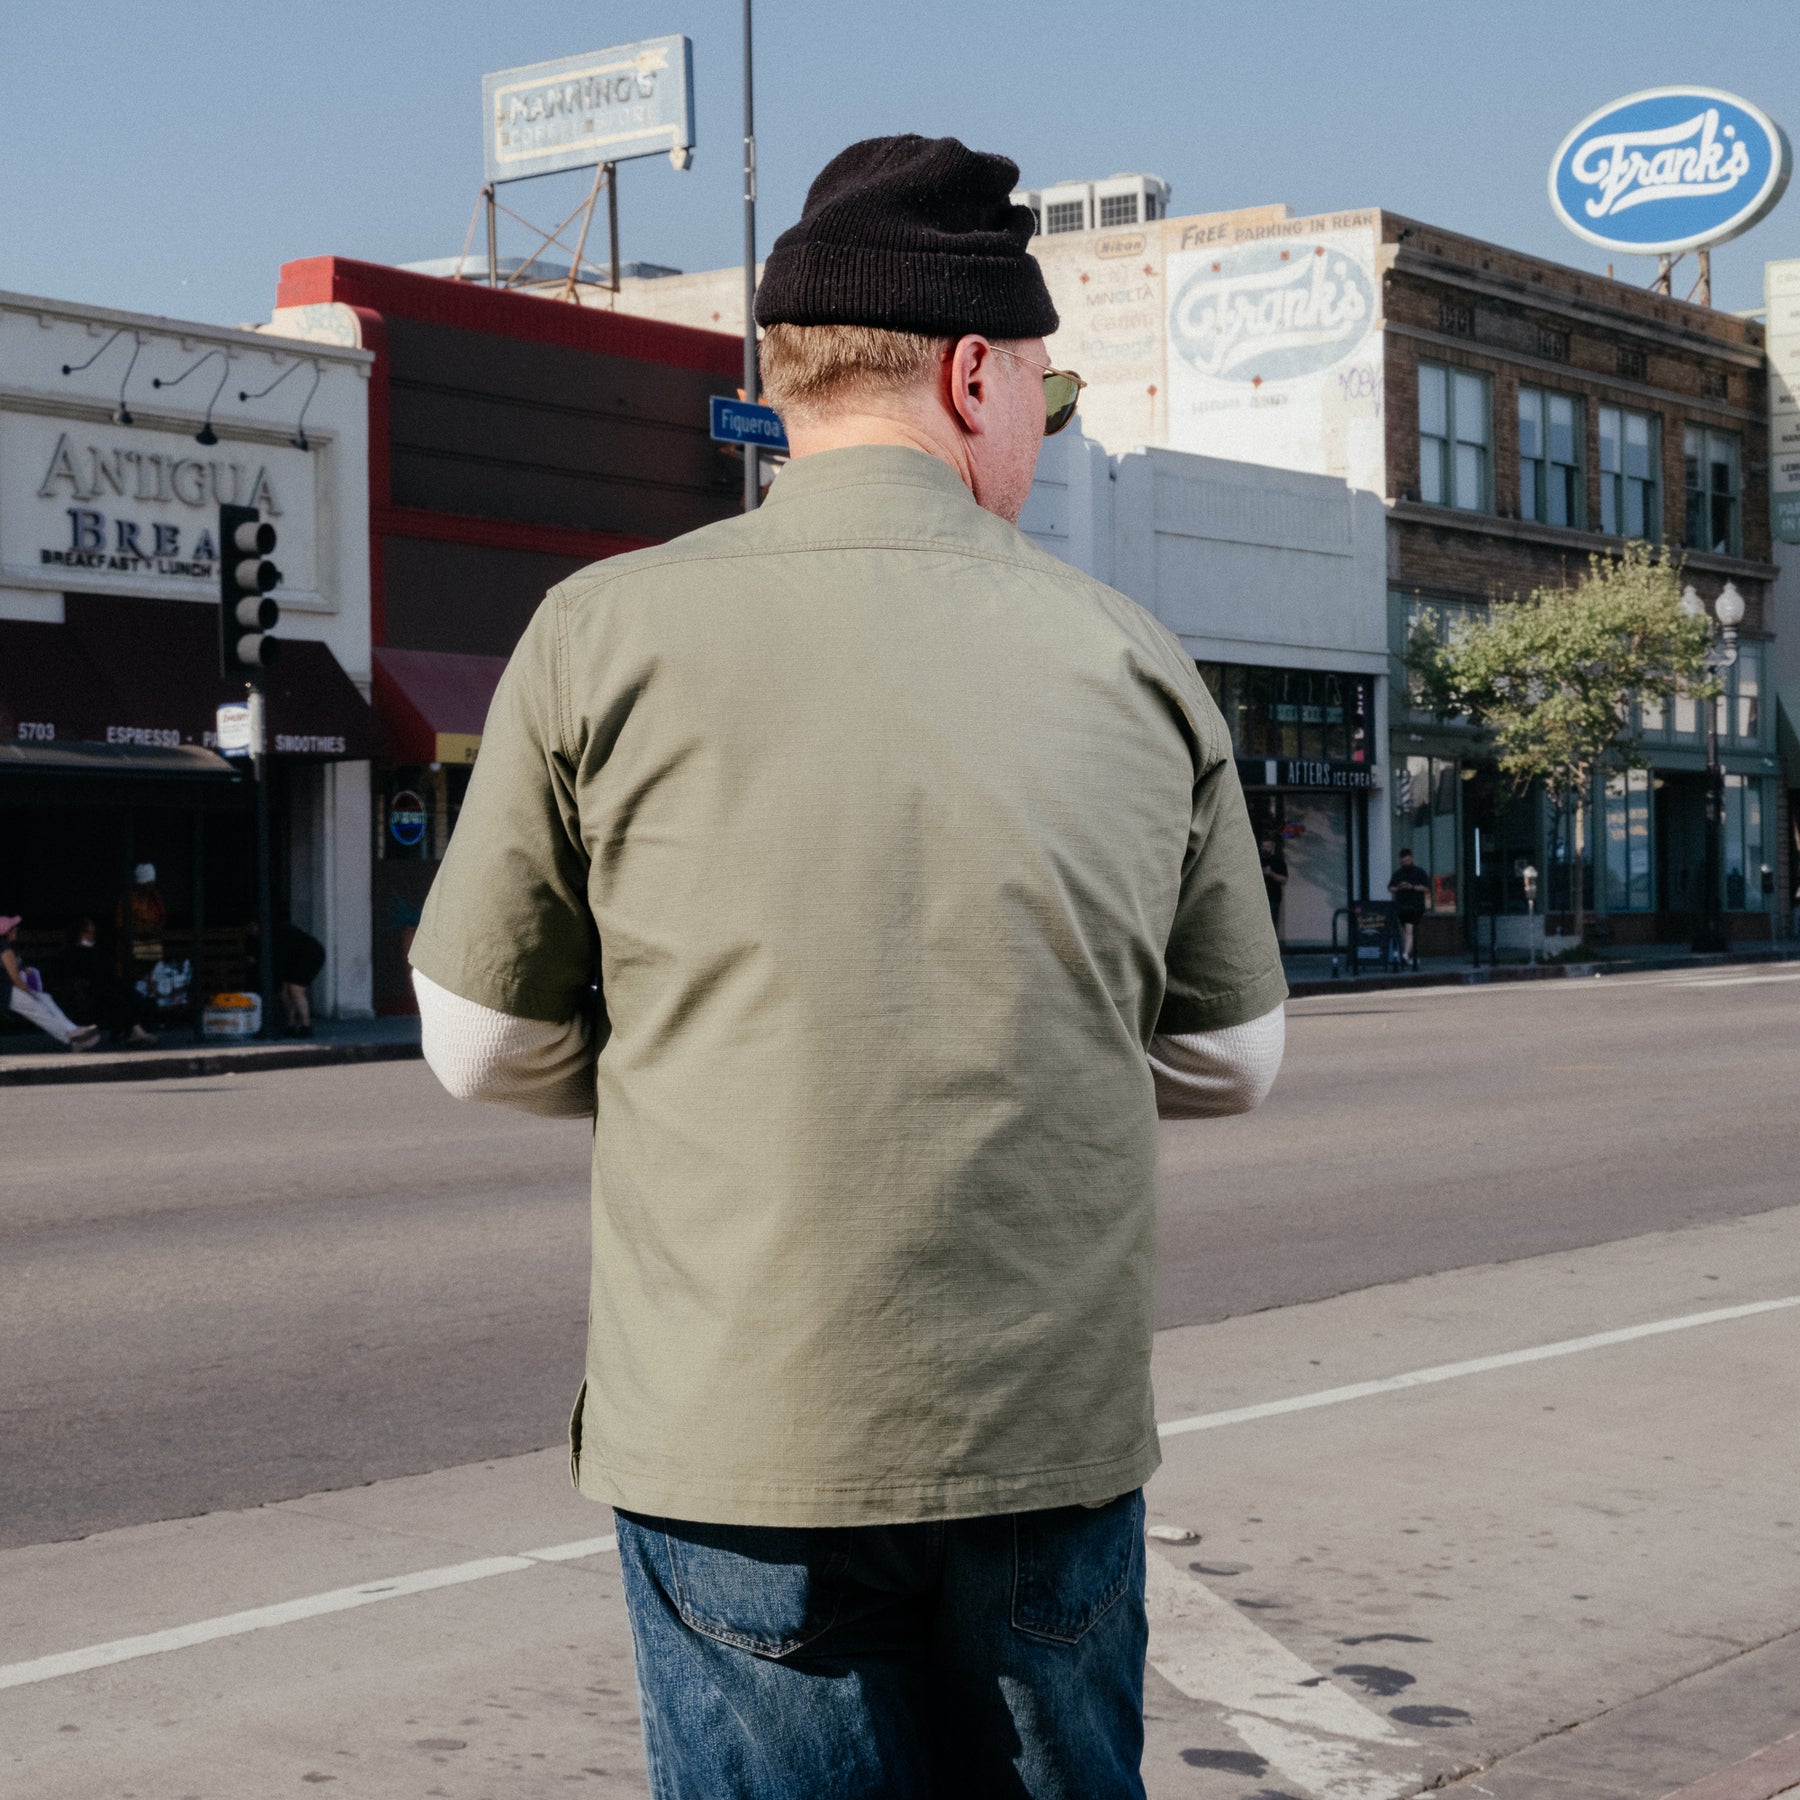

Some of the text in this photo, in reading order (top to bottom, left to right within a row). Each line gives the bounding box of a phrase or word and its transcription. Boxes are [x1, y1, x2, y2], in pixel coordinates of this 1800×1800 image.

[1571, 107, 1750, 218] Frank's
[1100, 240, 1142, 253] Nikon
[1181, 214, 1373, 250] FREE PARKING IN REAR
[1086, 282, 1155, 307] MINOLTA
[1174, 250, 1366, 375] Frank's
[721, 408, 781, 438] Figueroa
[37, 432, 283, 518] ANTIGUA
[40, 548, 212, 578] BREAKFAST LUNCH
[18, 722, 55, 741] 5703
[106, 725, 181, 747] ESPRESSO
[275, 734, 346, 753] SMOOTHIES
[1288, 761, 1330, 786] AFTERS
[1333, 771, 1347, 787] ICE
